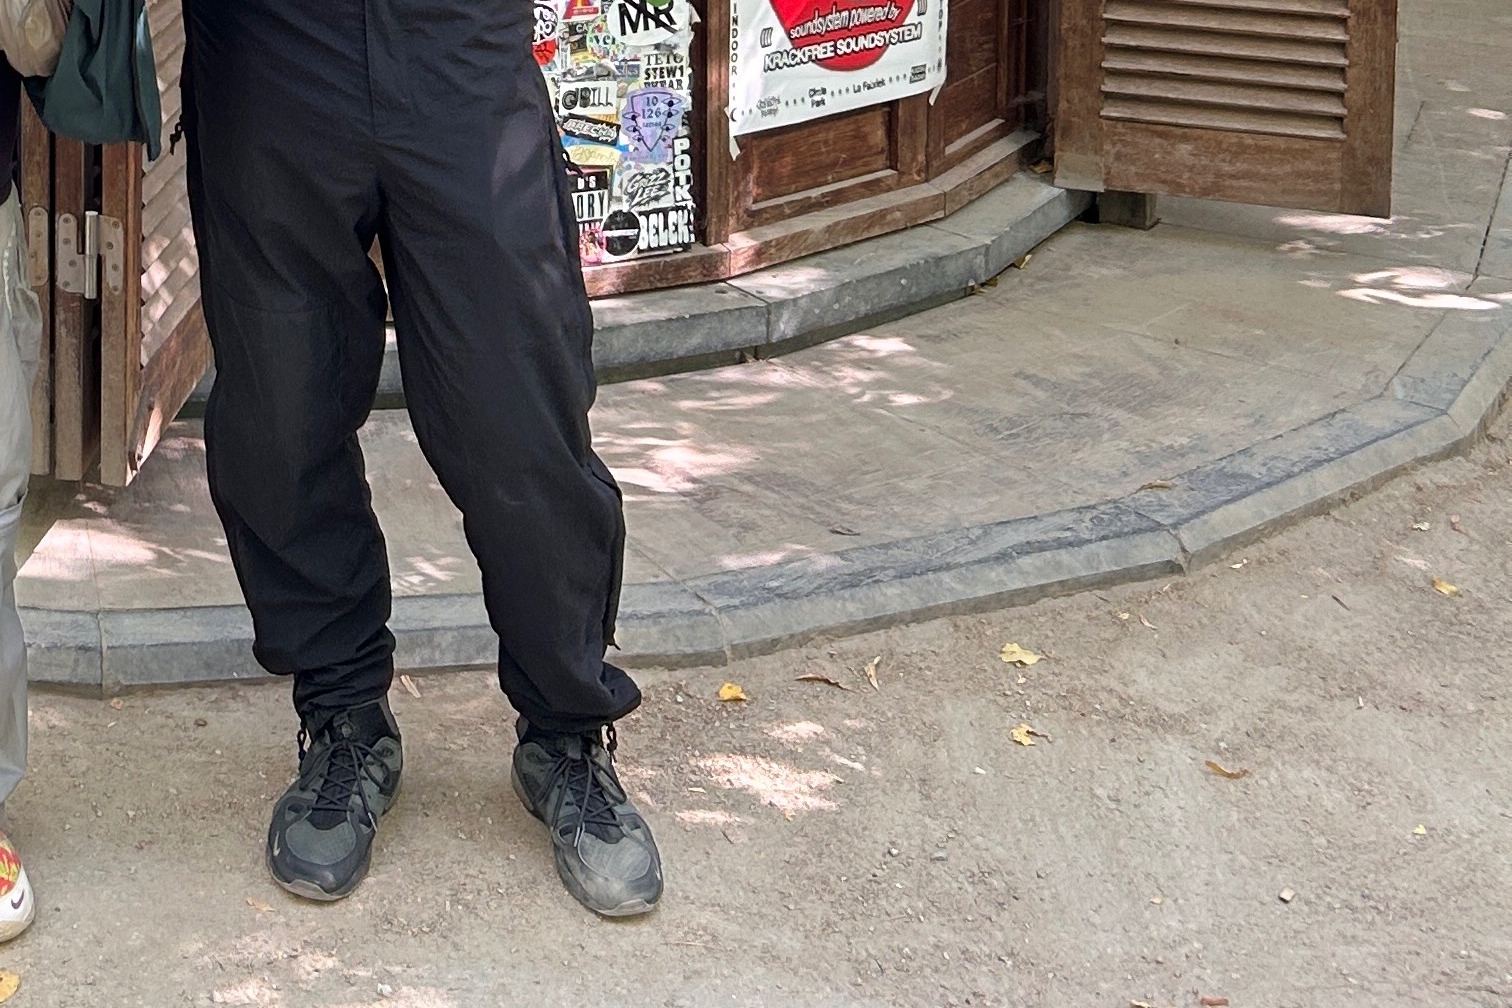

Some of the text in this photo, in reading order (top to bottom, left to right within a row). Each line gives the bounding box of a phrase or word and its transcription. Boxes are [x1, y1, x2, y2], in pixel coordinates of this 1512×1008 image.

[789, 0, 902, 39] soundsystem powered by
[763, 22, 922, 72] KRACKFREE SOUNDSYSTEM
[641, 107, 662, 119] 126
[646, 96, 658, 107] 10
